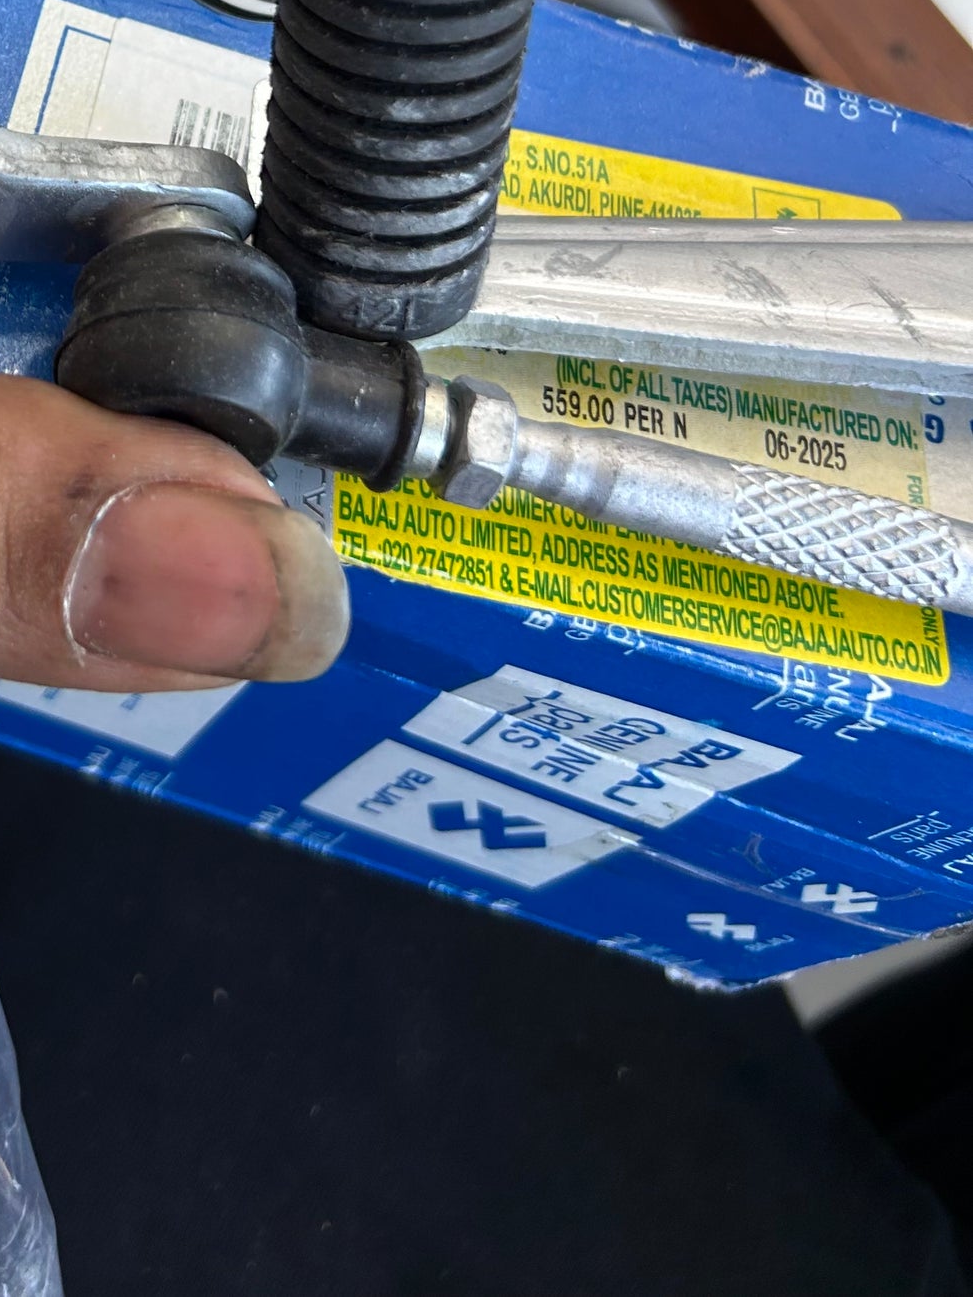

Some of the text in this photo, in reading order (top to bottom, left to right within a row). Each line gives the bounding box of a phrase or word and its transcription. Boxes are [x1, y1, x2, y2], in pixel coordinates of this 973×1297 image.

[526, 144, 610, 185] S.NO.51A
[499, 173, 524, 206] AD,
[528, 177, 595, 216] AKURDI,
[542, 384, 688, 440] 559.00 PER N
[556, 355, 734, 422] (INCL. OF ALL TAXES)
[735, 388, 882, 442] MANUFACTURED
[885, 417, 919, 450] ON:
[764, 428, 848, 471] 06-2025
[339, 490, 399, 531] BAJAJ
[403, 504, 455, 543] AUTO
[460, 515, 537, 564] LIMITED,
[541, 533, 630, 578] ADDRESS
[634, 551, 658, 582] AS
[663, 555, 770, 604] MENTIONED
[775, 578, 844, 619] ABOVE.
[416, 545, 495, 590] 27472851
[499, 563, 513, 593] &
[499, 700, 594, 750] parts
[835, 674, 892, 742] AJAJ
[531, 717, 666, 783] GENUINE
[603, 738, 745, 807] BAJAJ
[357, 767, 435, 815] BAJAJ
[890, 817, 952, 843] parts
[906, 826, 973, 860] ENUINE
